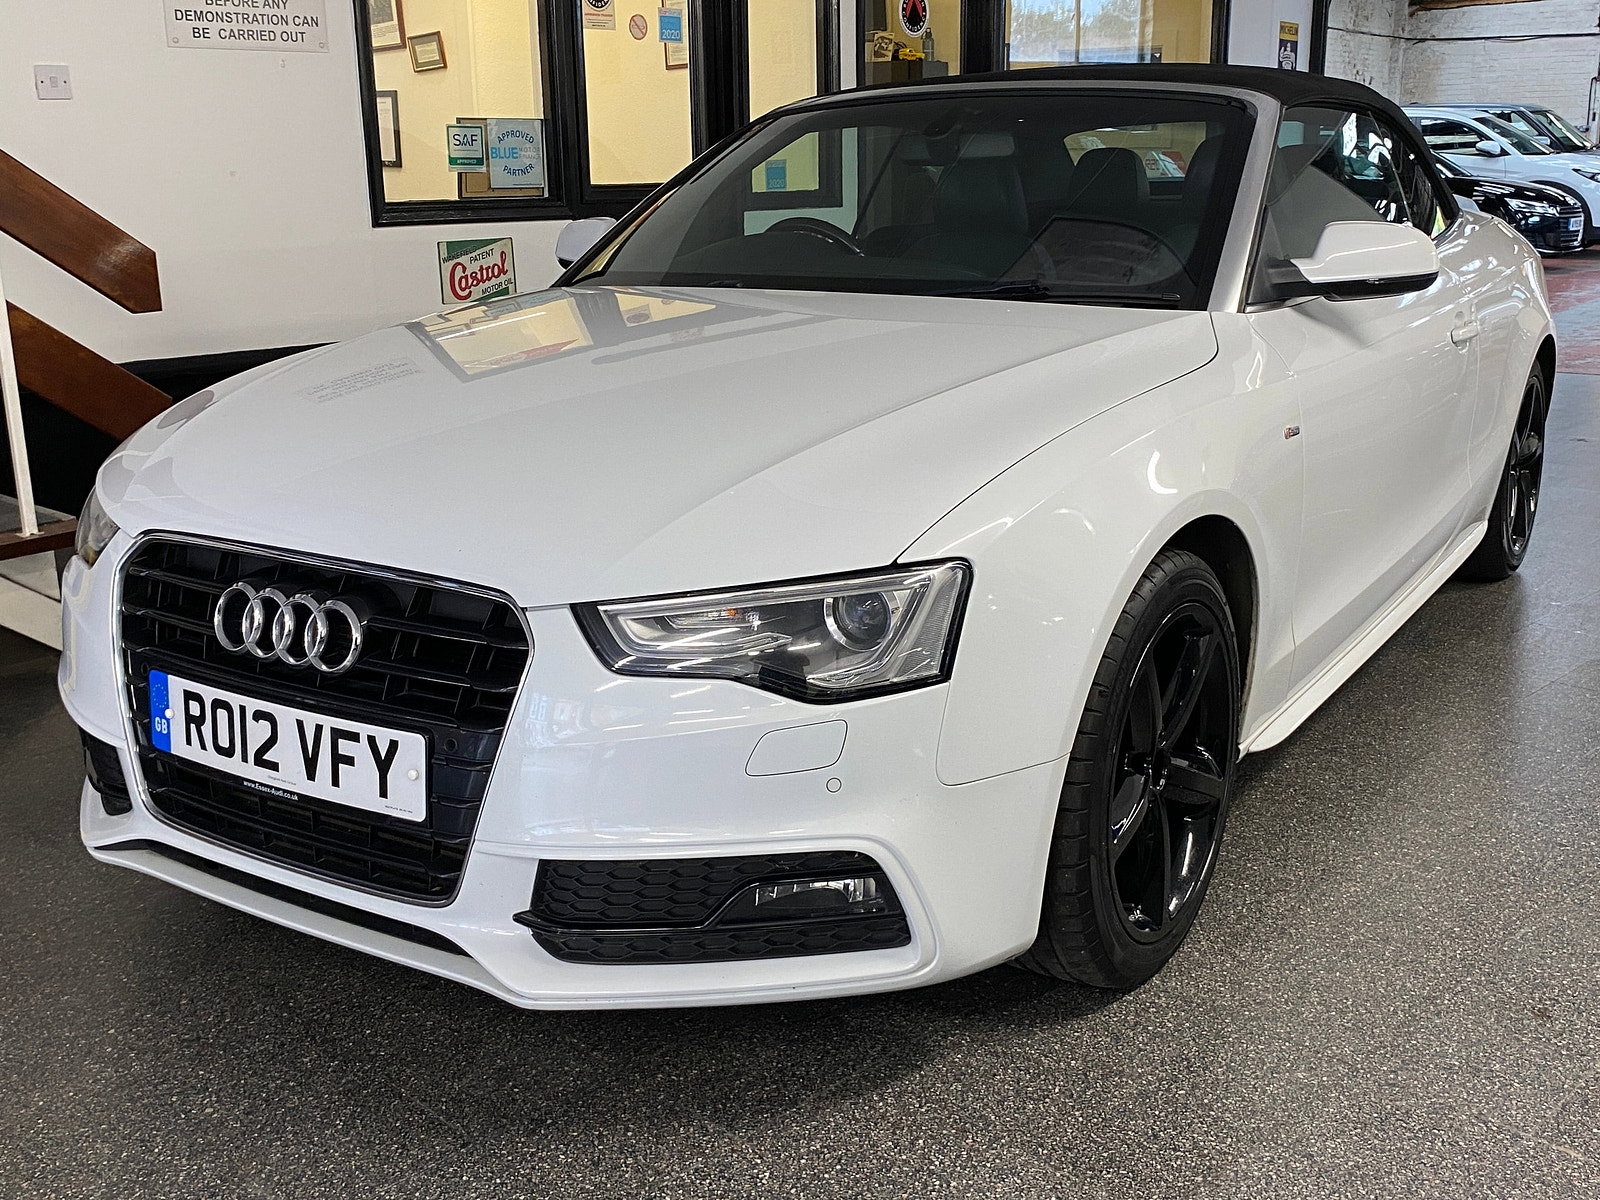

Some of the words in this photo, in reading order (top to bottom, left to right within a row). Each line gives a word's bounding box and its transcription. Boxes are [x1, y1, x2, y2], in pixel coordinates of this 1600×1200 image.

[262, 0, 289, 10] ANY
[174, 9, 289, 26] DEMONSTRATION
[292, 15, 319, 27] CAN
[192, 27, 211, 39] BE
[218, 28, 277, 42] CARRIED
[280, 31, 306, 43] OUT
[661, 29, 681, 40] 2020
[452, 133, 478, 147] SAF
[497, 129, 535, 144] APPROVED
[490, 146, 519, 160] BLUE
[503, 163, 535, 177] PARTNER
[469, 248, 495, 264] PATENT
[449, 250, 509, 301] Castrol
[481, 282, 503, 296] MOTOR
[503, 277, 514, 287] OIL
[154, 716, 169, 734] GB
[182, 688, 281, 773] RO12
[295, 718, 400, 800] VFY
[243, 780, 299, 801] www.Essex-Audi.co.uk
